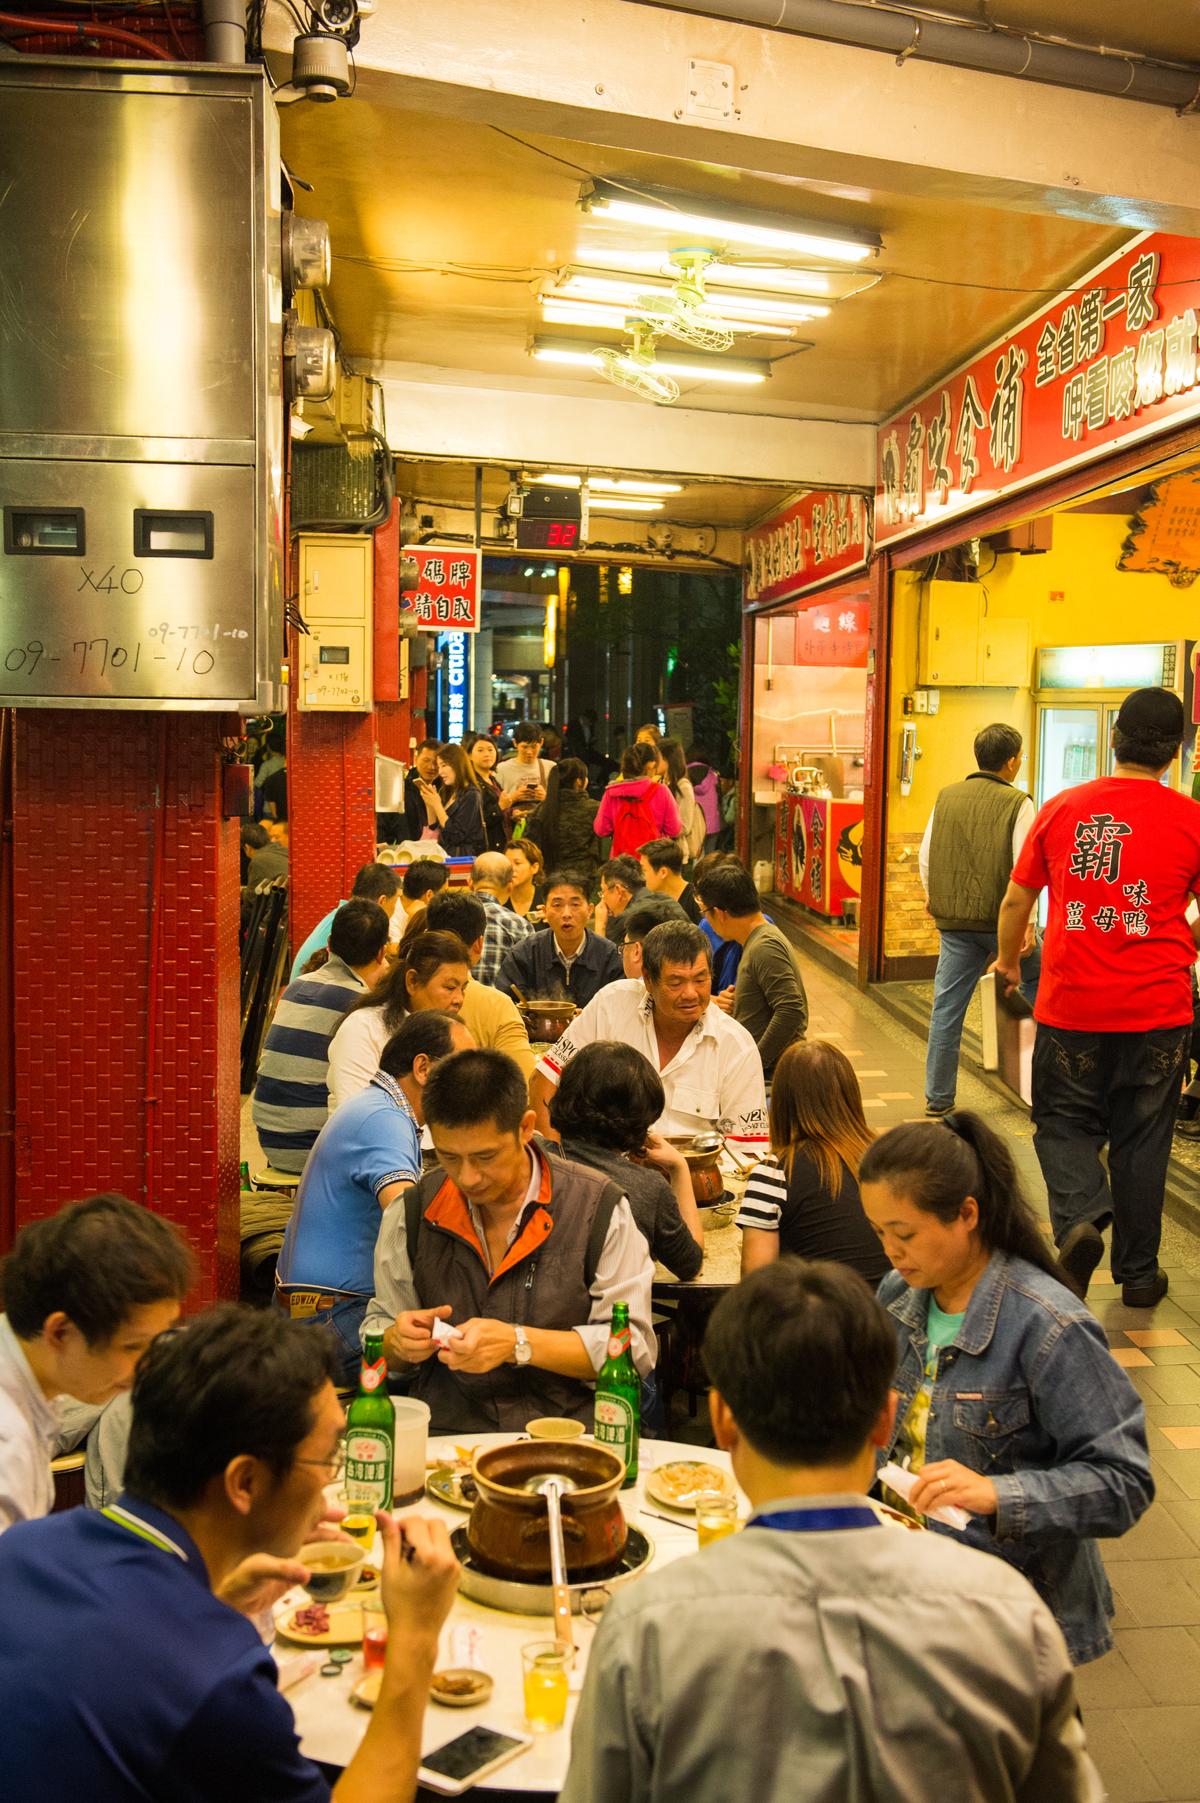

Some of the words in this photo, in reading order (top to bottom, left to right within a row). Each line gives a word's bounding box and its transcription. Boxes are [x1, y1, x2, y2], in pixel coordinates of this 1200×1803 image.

[1036, 252, 1159, 388] 全省第一家
[546, 523, 577, 547] 32
[402, 556, 472, 590] 碼牌
[415, 595, 473, 621] 請自取
[148, 622, 249, 644] 09-7701-10
[5, 638, 215, 677] 09-7701-10
[1069, 813, 1132, 884] 霸
[1122, 879, 1151, 907] 味
[1065, 900, 1150, 937] 薑母鴨
[290, 1295, 318, 1306] EDWIN
